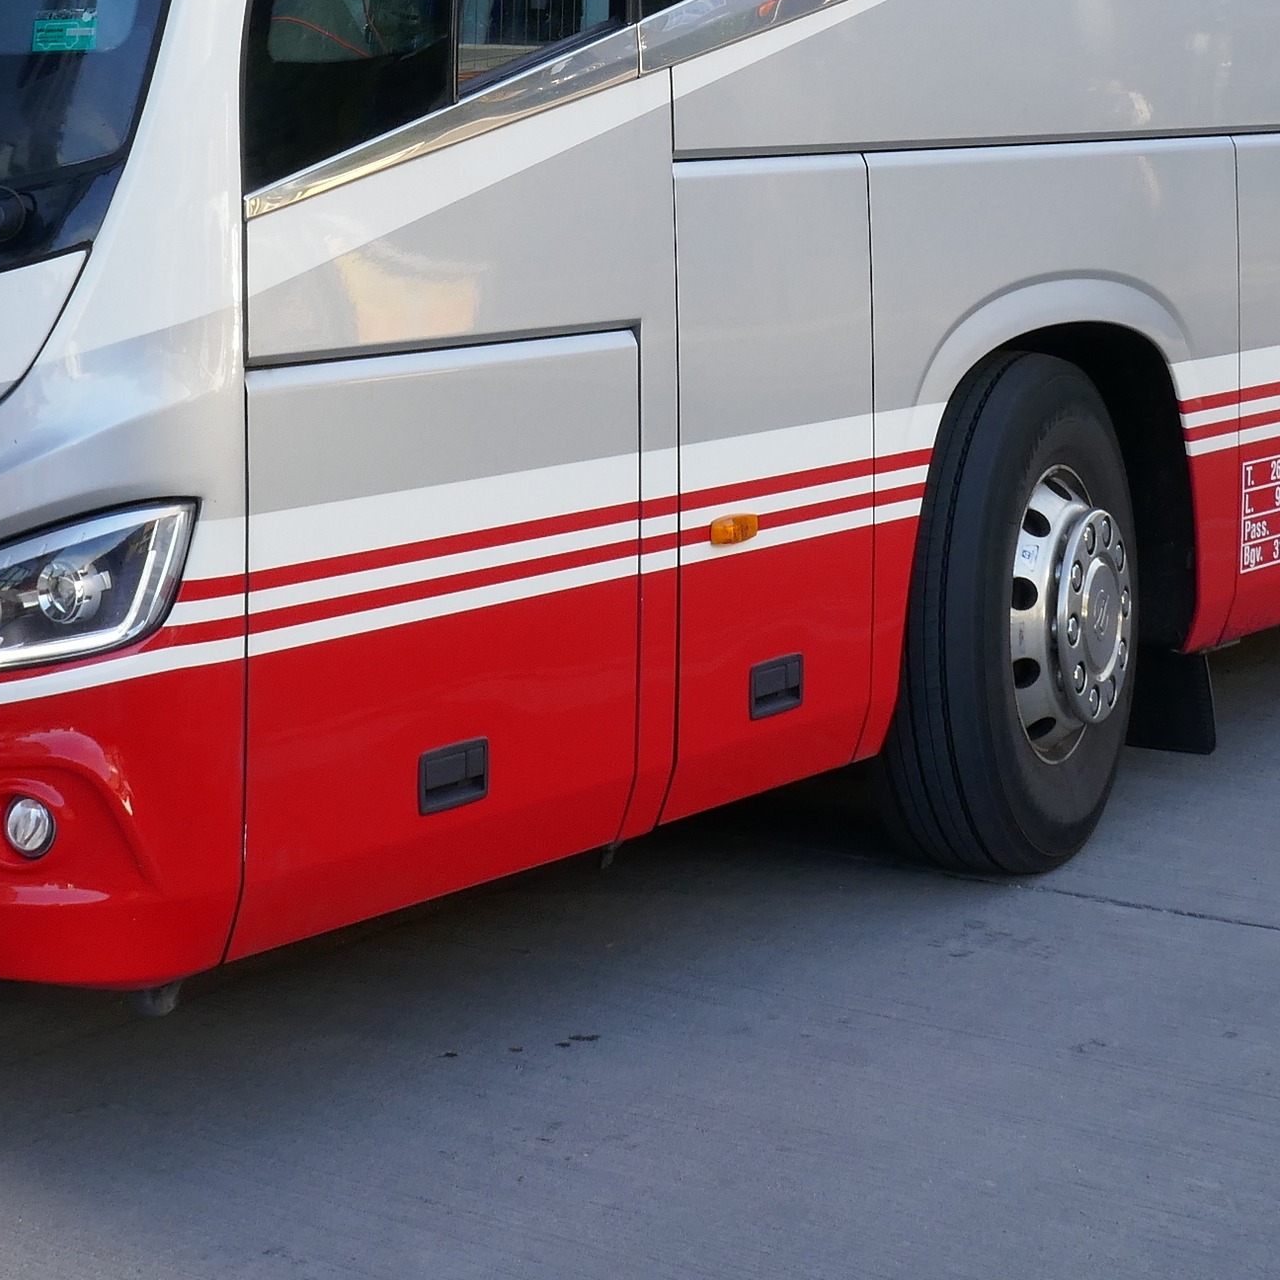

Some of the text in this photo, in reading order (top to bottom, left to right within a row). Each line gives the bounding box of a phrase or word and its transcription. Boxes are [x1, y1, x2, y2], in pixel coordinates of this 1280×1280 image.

[1246, 465, 1255, 486] T.
[1245, 493, 1254, 514] L.
[1244, 520, 1269, 541] Pass.
[1243, 545, 1263, 568] Bgv.
